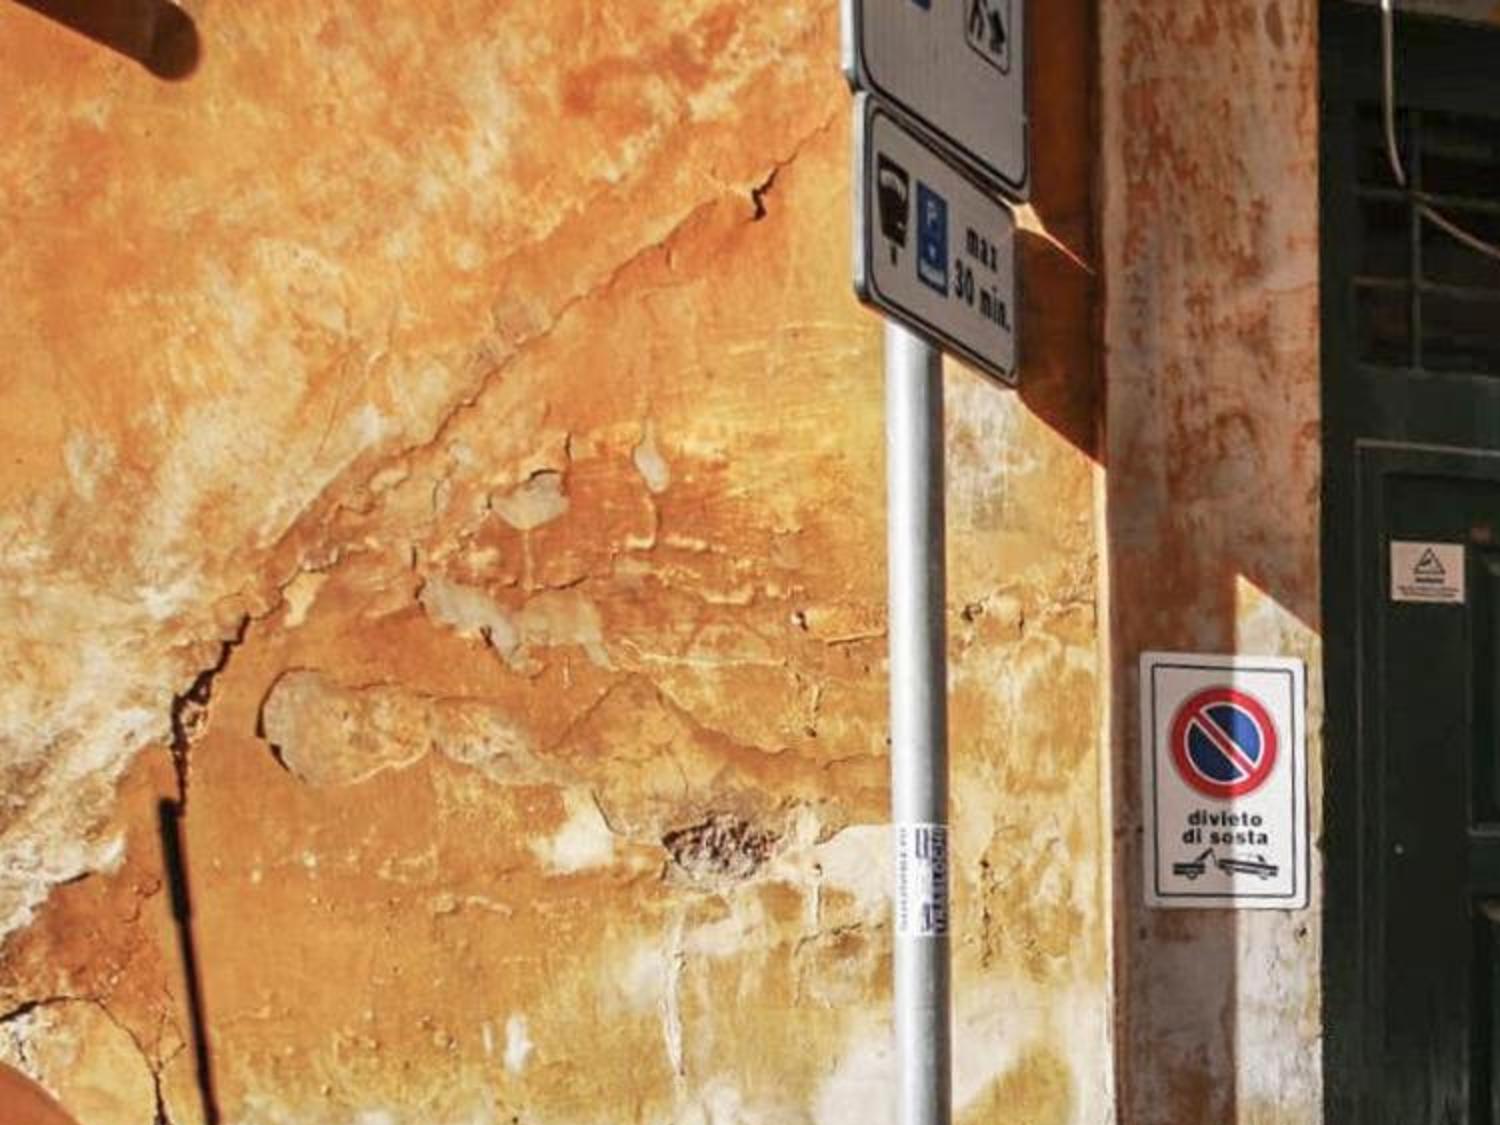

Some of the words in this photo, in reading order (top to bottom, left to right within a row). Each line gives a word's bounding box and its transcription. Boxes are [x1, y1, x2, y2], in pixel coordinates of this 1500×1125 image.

[966, 227, 998, 273] max
[955, 258, 975, 306] 30
[1188, 809, 1263, 827] divieto
[1182, 827, 1202, 844] di
[1210, 829, 1268, 845] sosta
